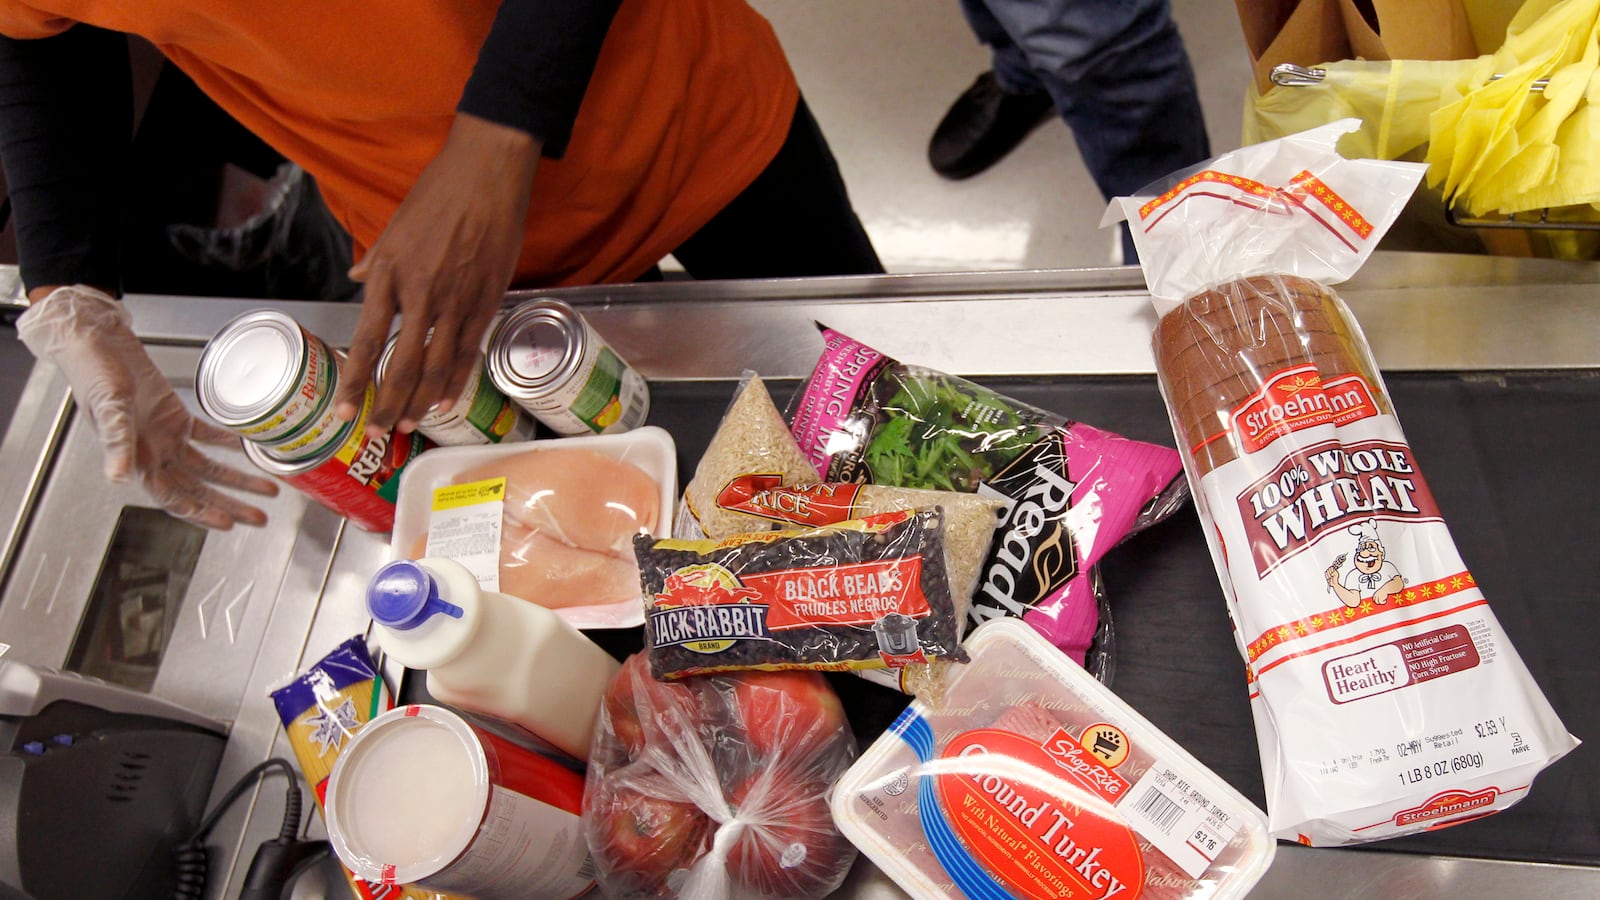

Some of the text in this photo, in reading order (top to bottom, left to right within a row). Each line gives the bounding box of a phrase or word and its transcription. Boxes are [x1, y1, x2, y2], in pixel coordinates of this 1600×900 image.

[826, 347, 879, 417] SPRING
[804, 343, 858, 450] FRESH ABY LETTUCES
[793, 395, 816, 443] PRINTA
[1246, 390, 1363, 437] Stroehmnn
[1316, 414, 1333, 422] DUT
[1334, 413, 1357, 424] AKERS
[1250, 465, 1309, 519] 100%
[1262, 476, 1419, 550] WHEAT
[967, 463, 1076, 626] Ready
[785, 569, 903, 601] BLACK BEANS
[794, 595, 898, 617] FRIJOLES NEGROS
[654, 606, 766, 644] JACK RABBIT
[699, 642, 720, 650] BRAND
[1402, 643, 1413, 651] NO
[1414, 636, 1440, 648] Artificial
[1331, 657, 1377, 679] Heart
[1409, 651, 1466, 671] NO High Fructose
[1412, 665, 1449, 680] Corn Syrup
[1424, 728, 1463, 744] Suggested
[1474, 719, 1499, 739] $2.69
[1433, 737, 1459, 750] Retail
[1511, 744, 1531, 755] PARVE
[1048, 740, 1121, 794] ShopRite
[1398, 752, 1484, 785] 1 LB 8 OZ (680g)
[1210, 805, 1231, 823] TURKEY
[1402, 795, 1489, 822] Stroehmann
[963, 793, 985, 820] With
[1024, 849, 1074, 898] Flavorings
[1040, 809, 1126, 899] Turkey
[1194, 830, 1217, 851] $3.16
